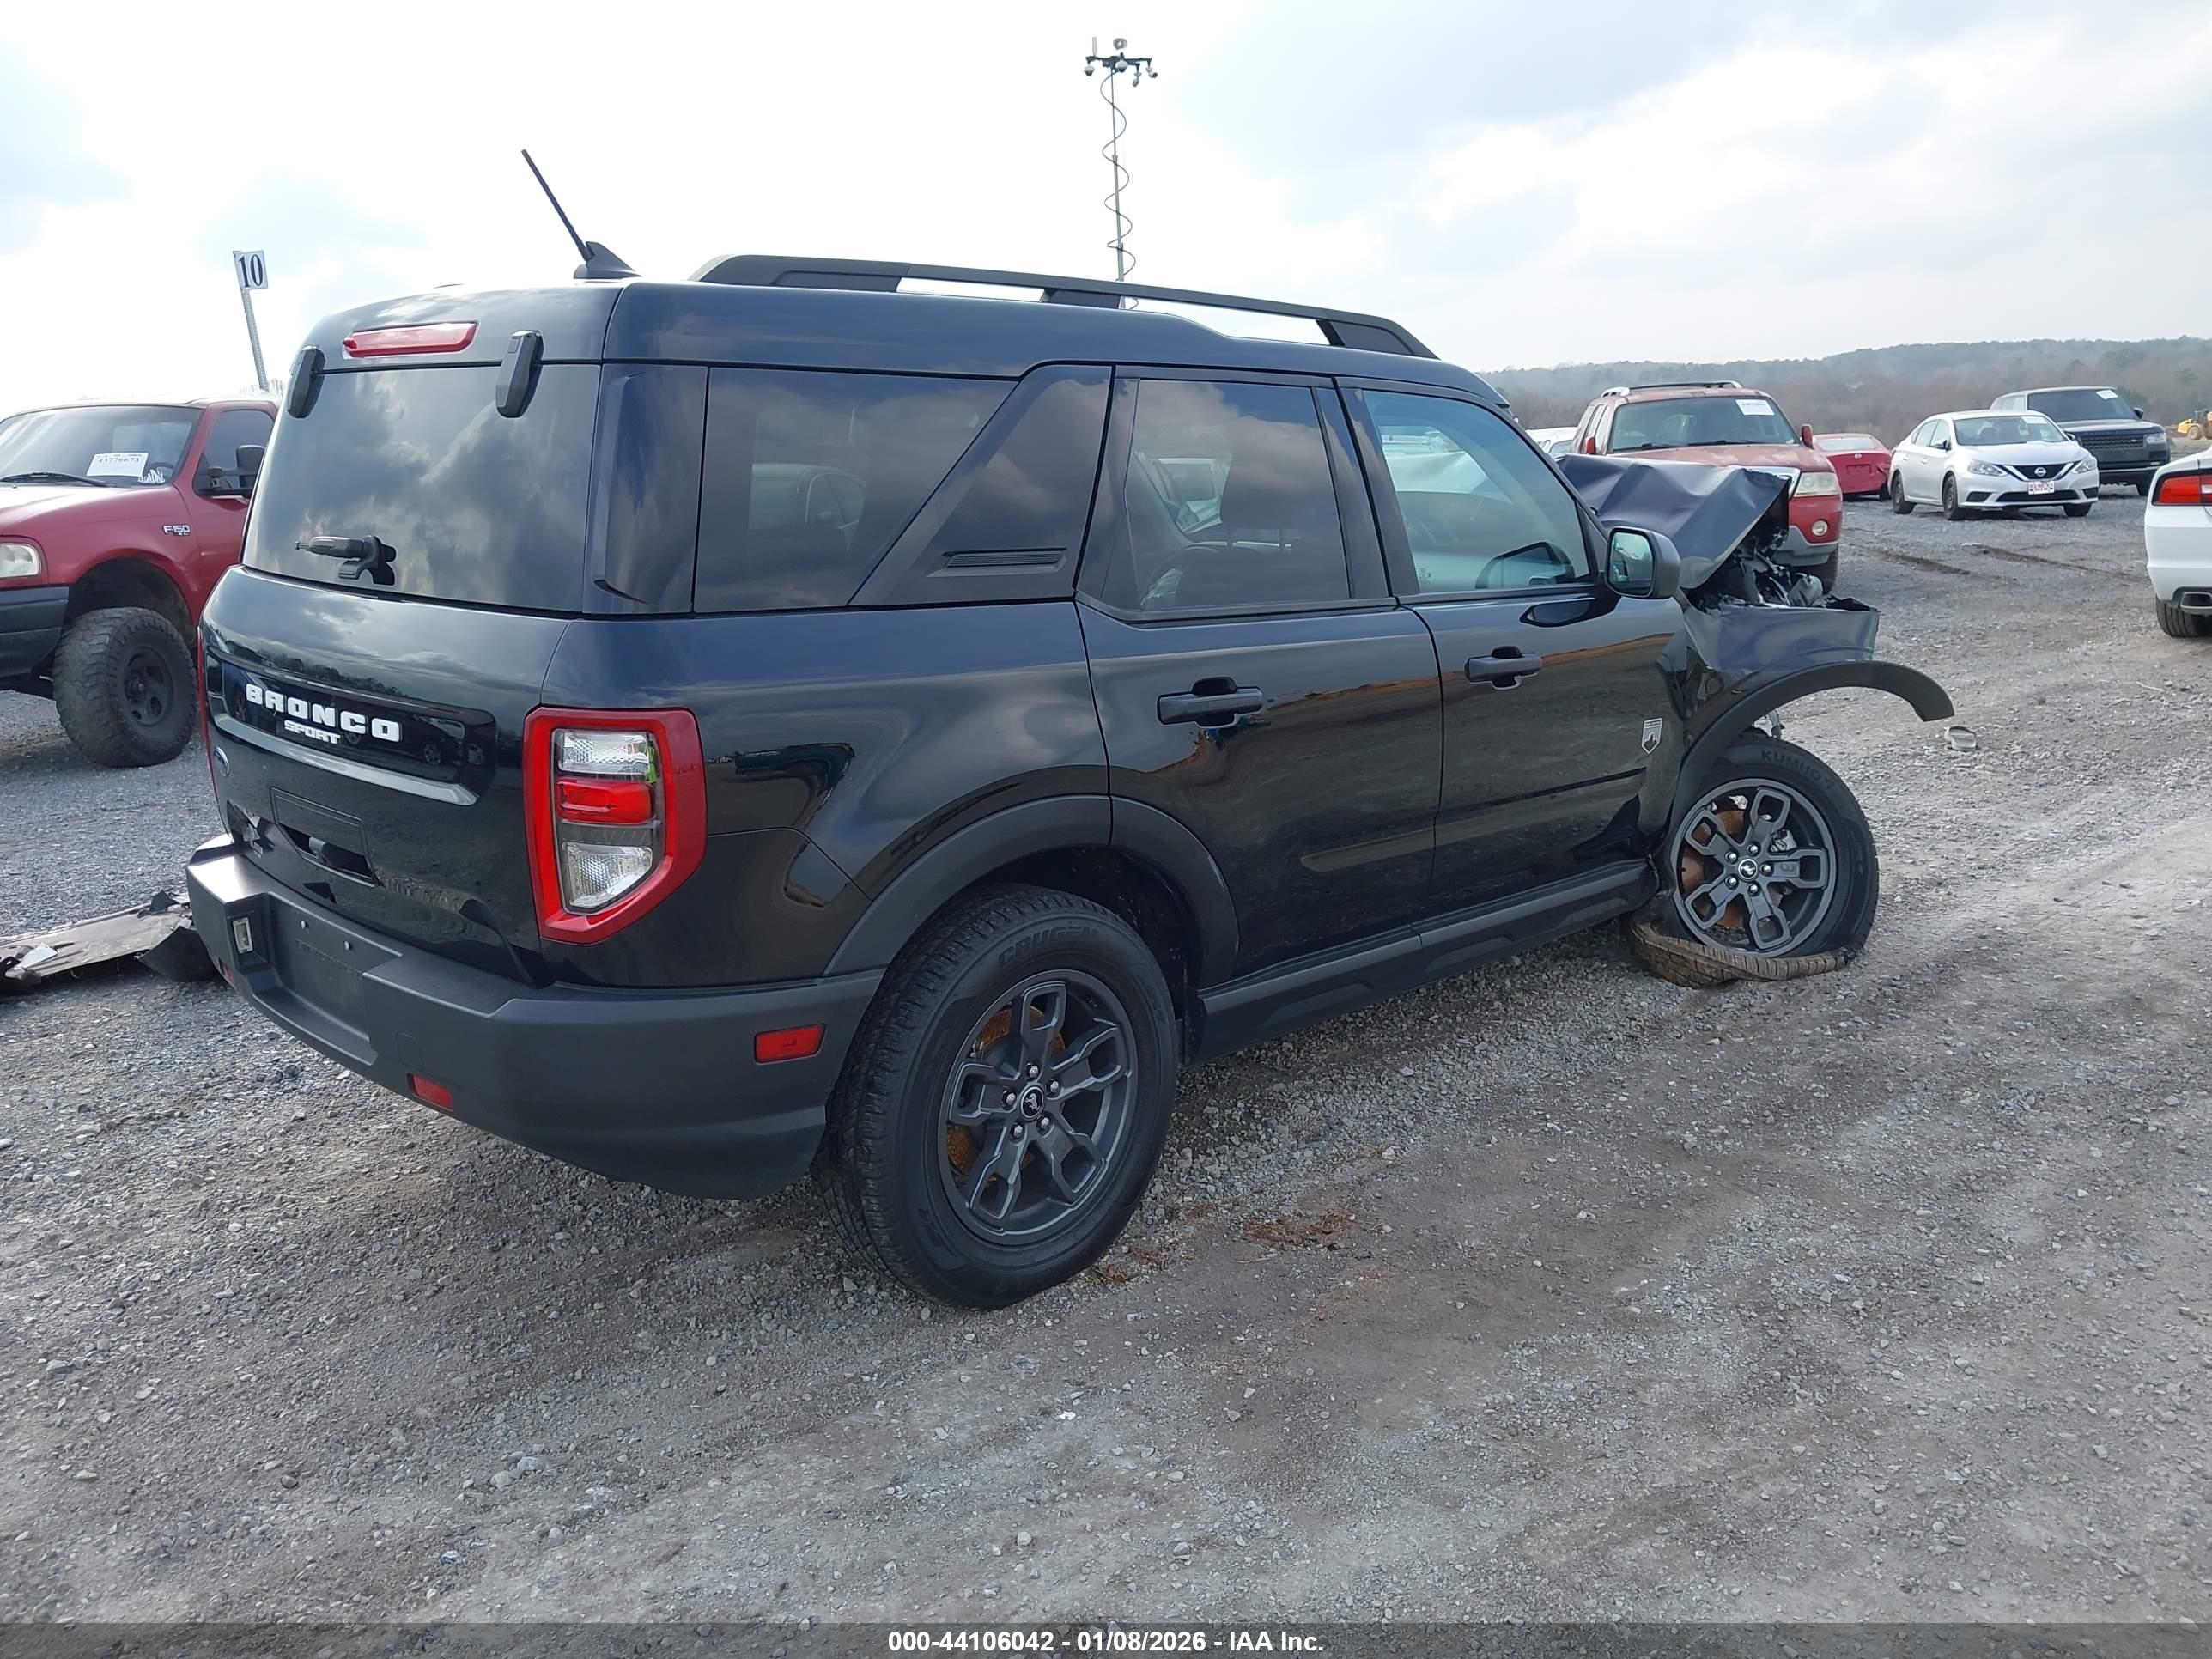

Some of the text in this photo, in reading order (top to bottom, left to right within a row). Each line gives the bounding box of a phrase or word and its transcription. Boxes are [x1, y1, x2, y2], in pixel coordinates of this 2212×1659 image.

[239, 254, 263, 288] 10
[246, 684, 401, 743] BRONCO
[283, 720, 341, 744] SPORT
[1760, 749, 1821, 781] KUMHO
